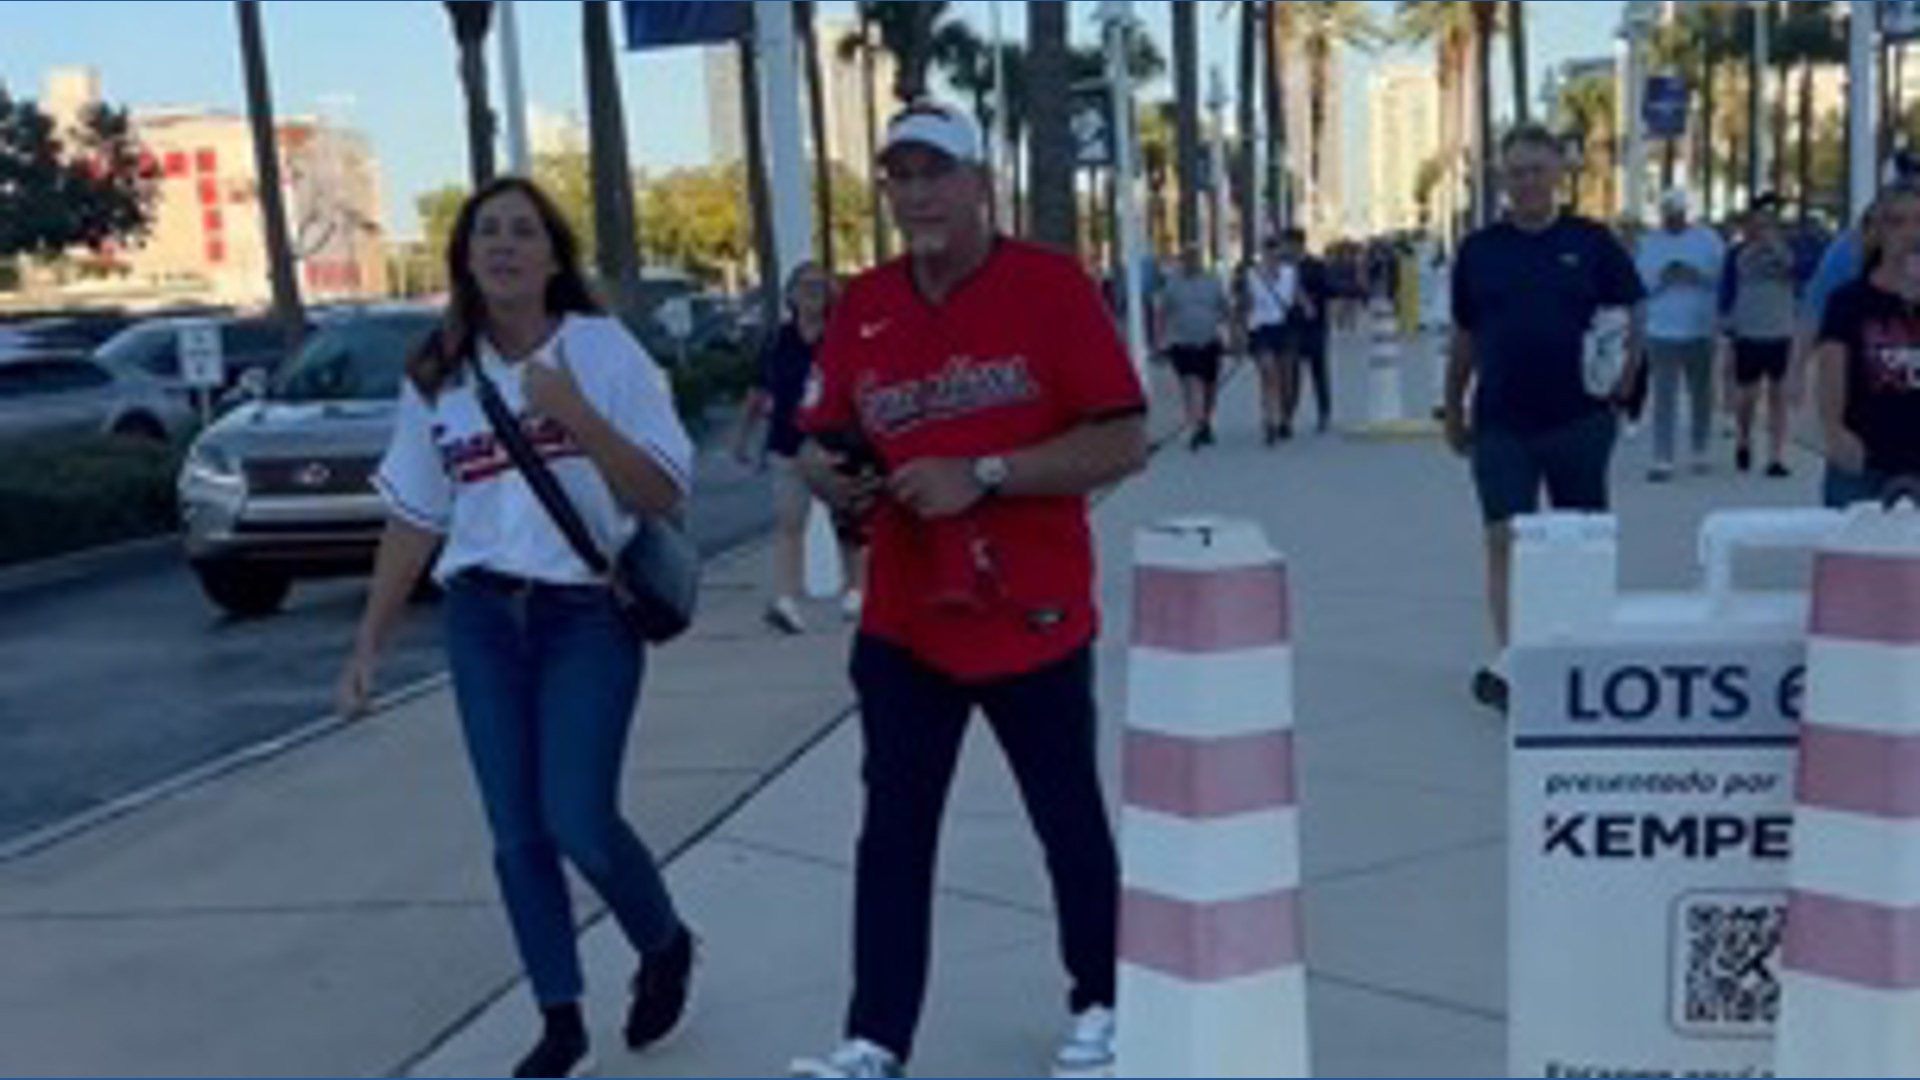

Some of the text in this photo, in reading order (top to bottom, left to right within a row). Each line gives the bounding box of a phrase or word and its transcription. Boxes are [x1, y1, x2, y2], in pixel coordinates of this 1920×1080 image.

[1568, 665, 1750, 721] LOTS
[1545, 768, 1777, 799] presentado por
[1544, 813, 1794, 859] KEMPE
